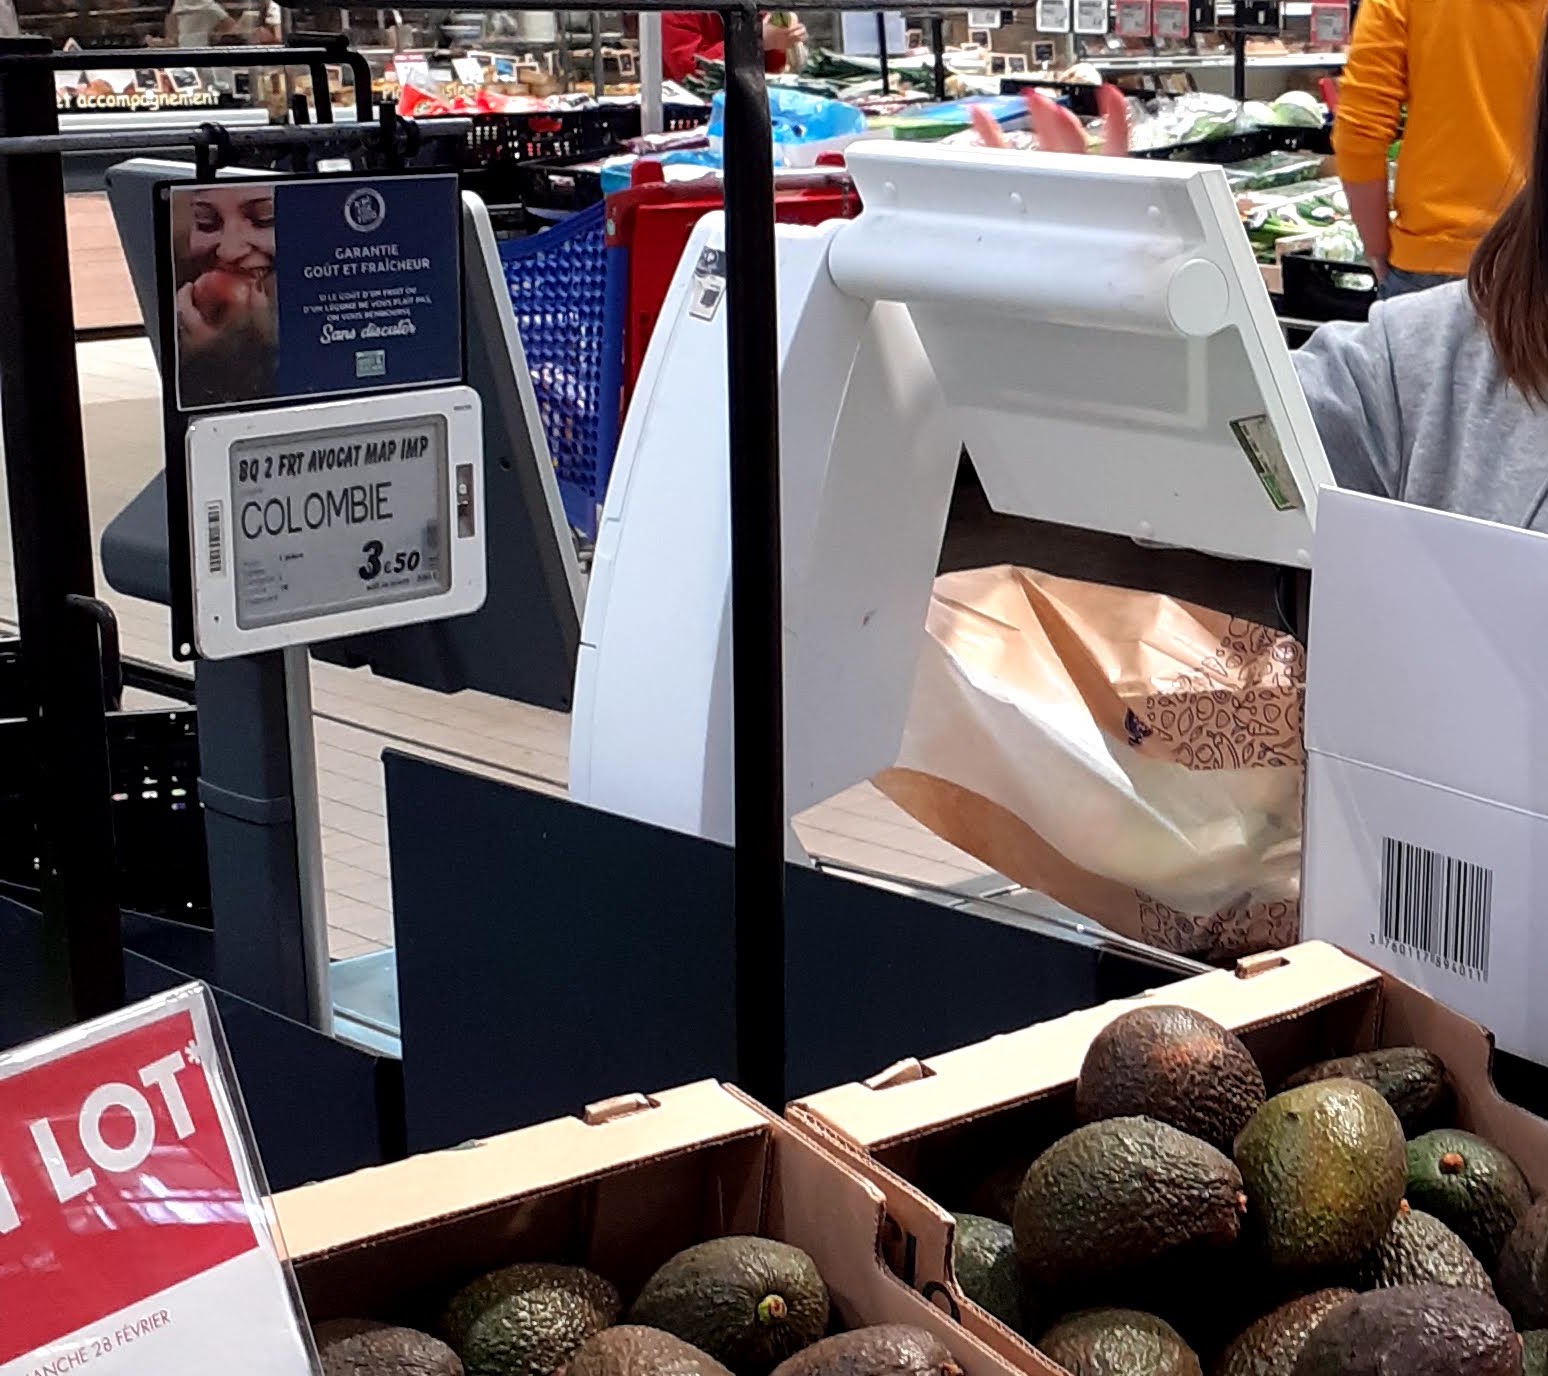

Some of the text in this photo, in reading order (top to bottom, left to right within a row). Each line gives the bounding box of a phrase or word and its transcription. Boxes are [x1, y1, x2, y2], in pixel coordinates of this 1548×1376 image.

[335, 244, 399, 261] GARANTIE
[342, 262, 357, 276] ET
[319, 323, 356, 344] Sans
[264, 458, 273, 480] 2
[278, 451, 304, 476] FRT
[308, 444, 362, 473] AVOCAT
[365, 439, 397, 464] MAP
[400, 435, 429, 460] IMP
[240, 481, 394, 540] COLOMBIE
[92, 1336, 113, 1358] 28
[115, 1309, 171, 1347] FÉVRIER
